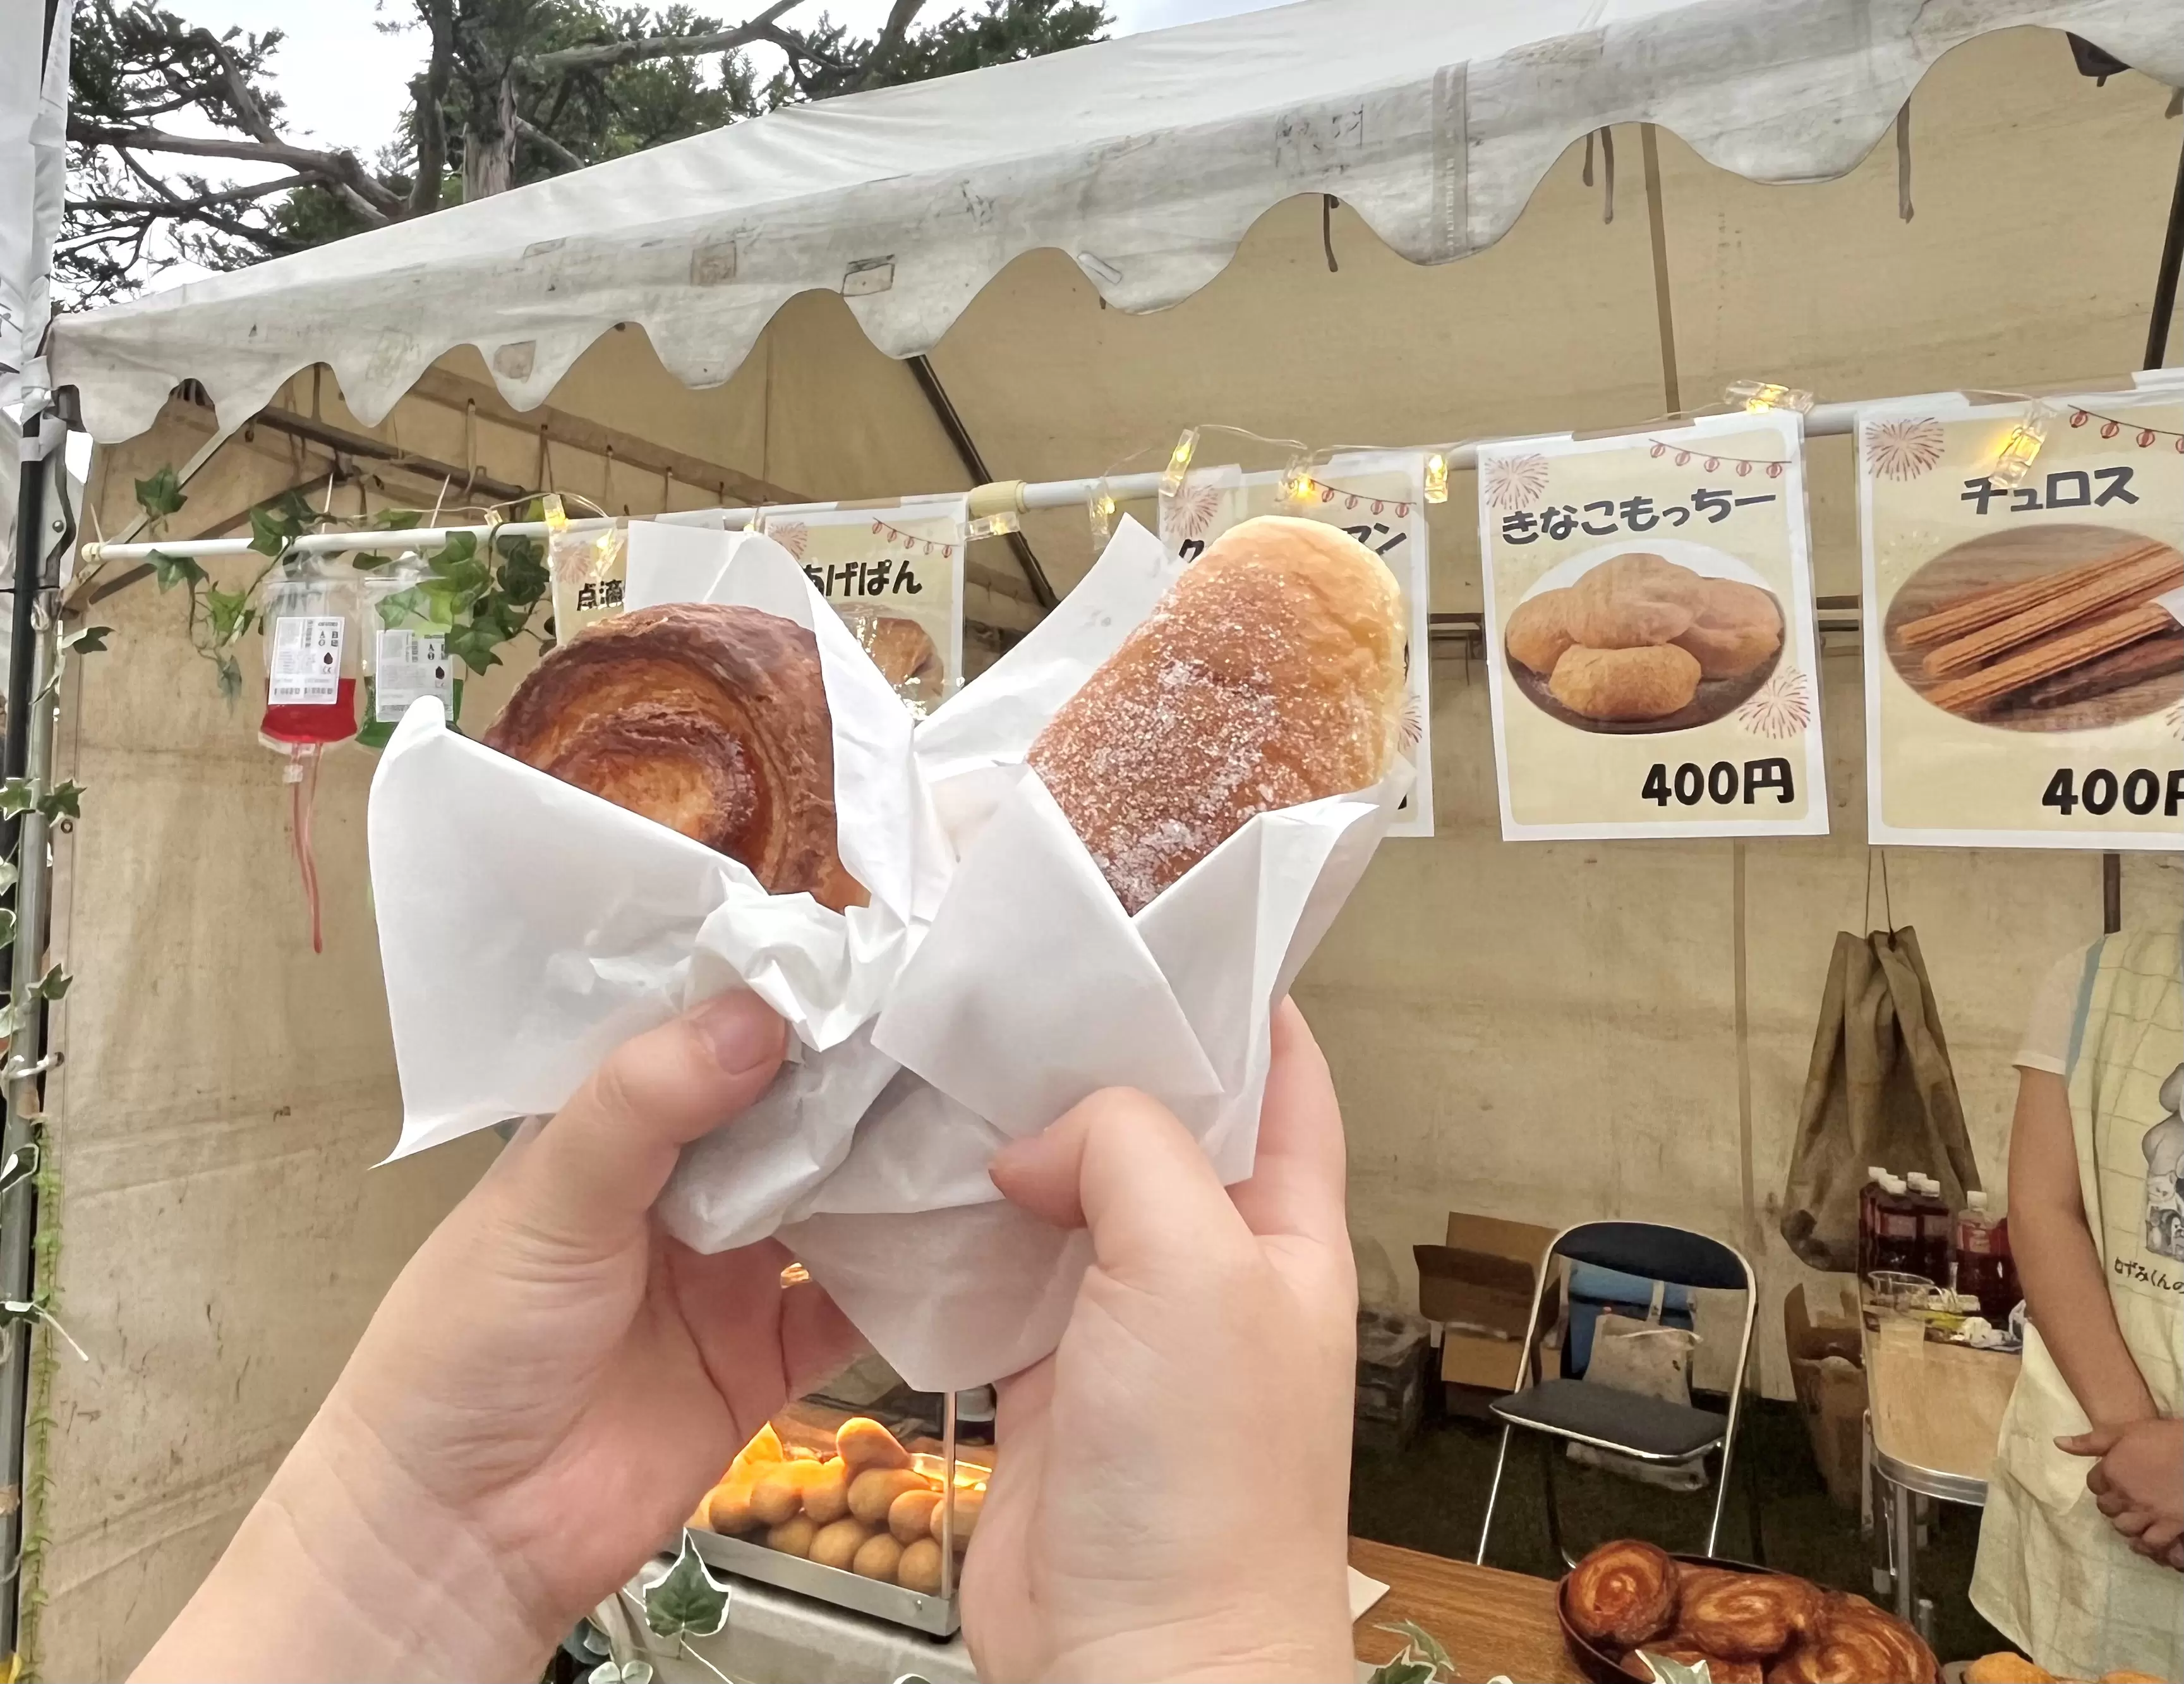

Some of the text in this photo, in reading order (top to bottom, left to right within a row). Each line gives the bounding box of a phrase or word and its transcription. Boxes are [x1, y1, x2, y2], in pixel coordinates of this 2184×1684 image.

[1961, 466, 2139, 515] チュロス
[1502, 488, 1776, 545] きなこもっちー
[1641, 757, 1795, 807] 400円
